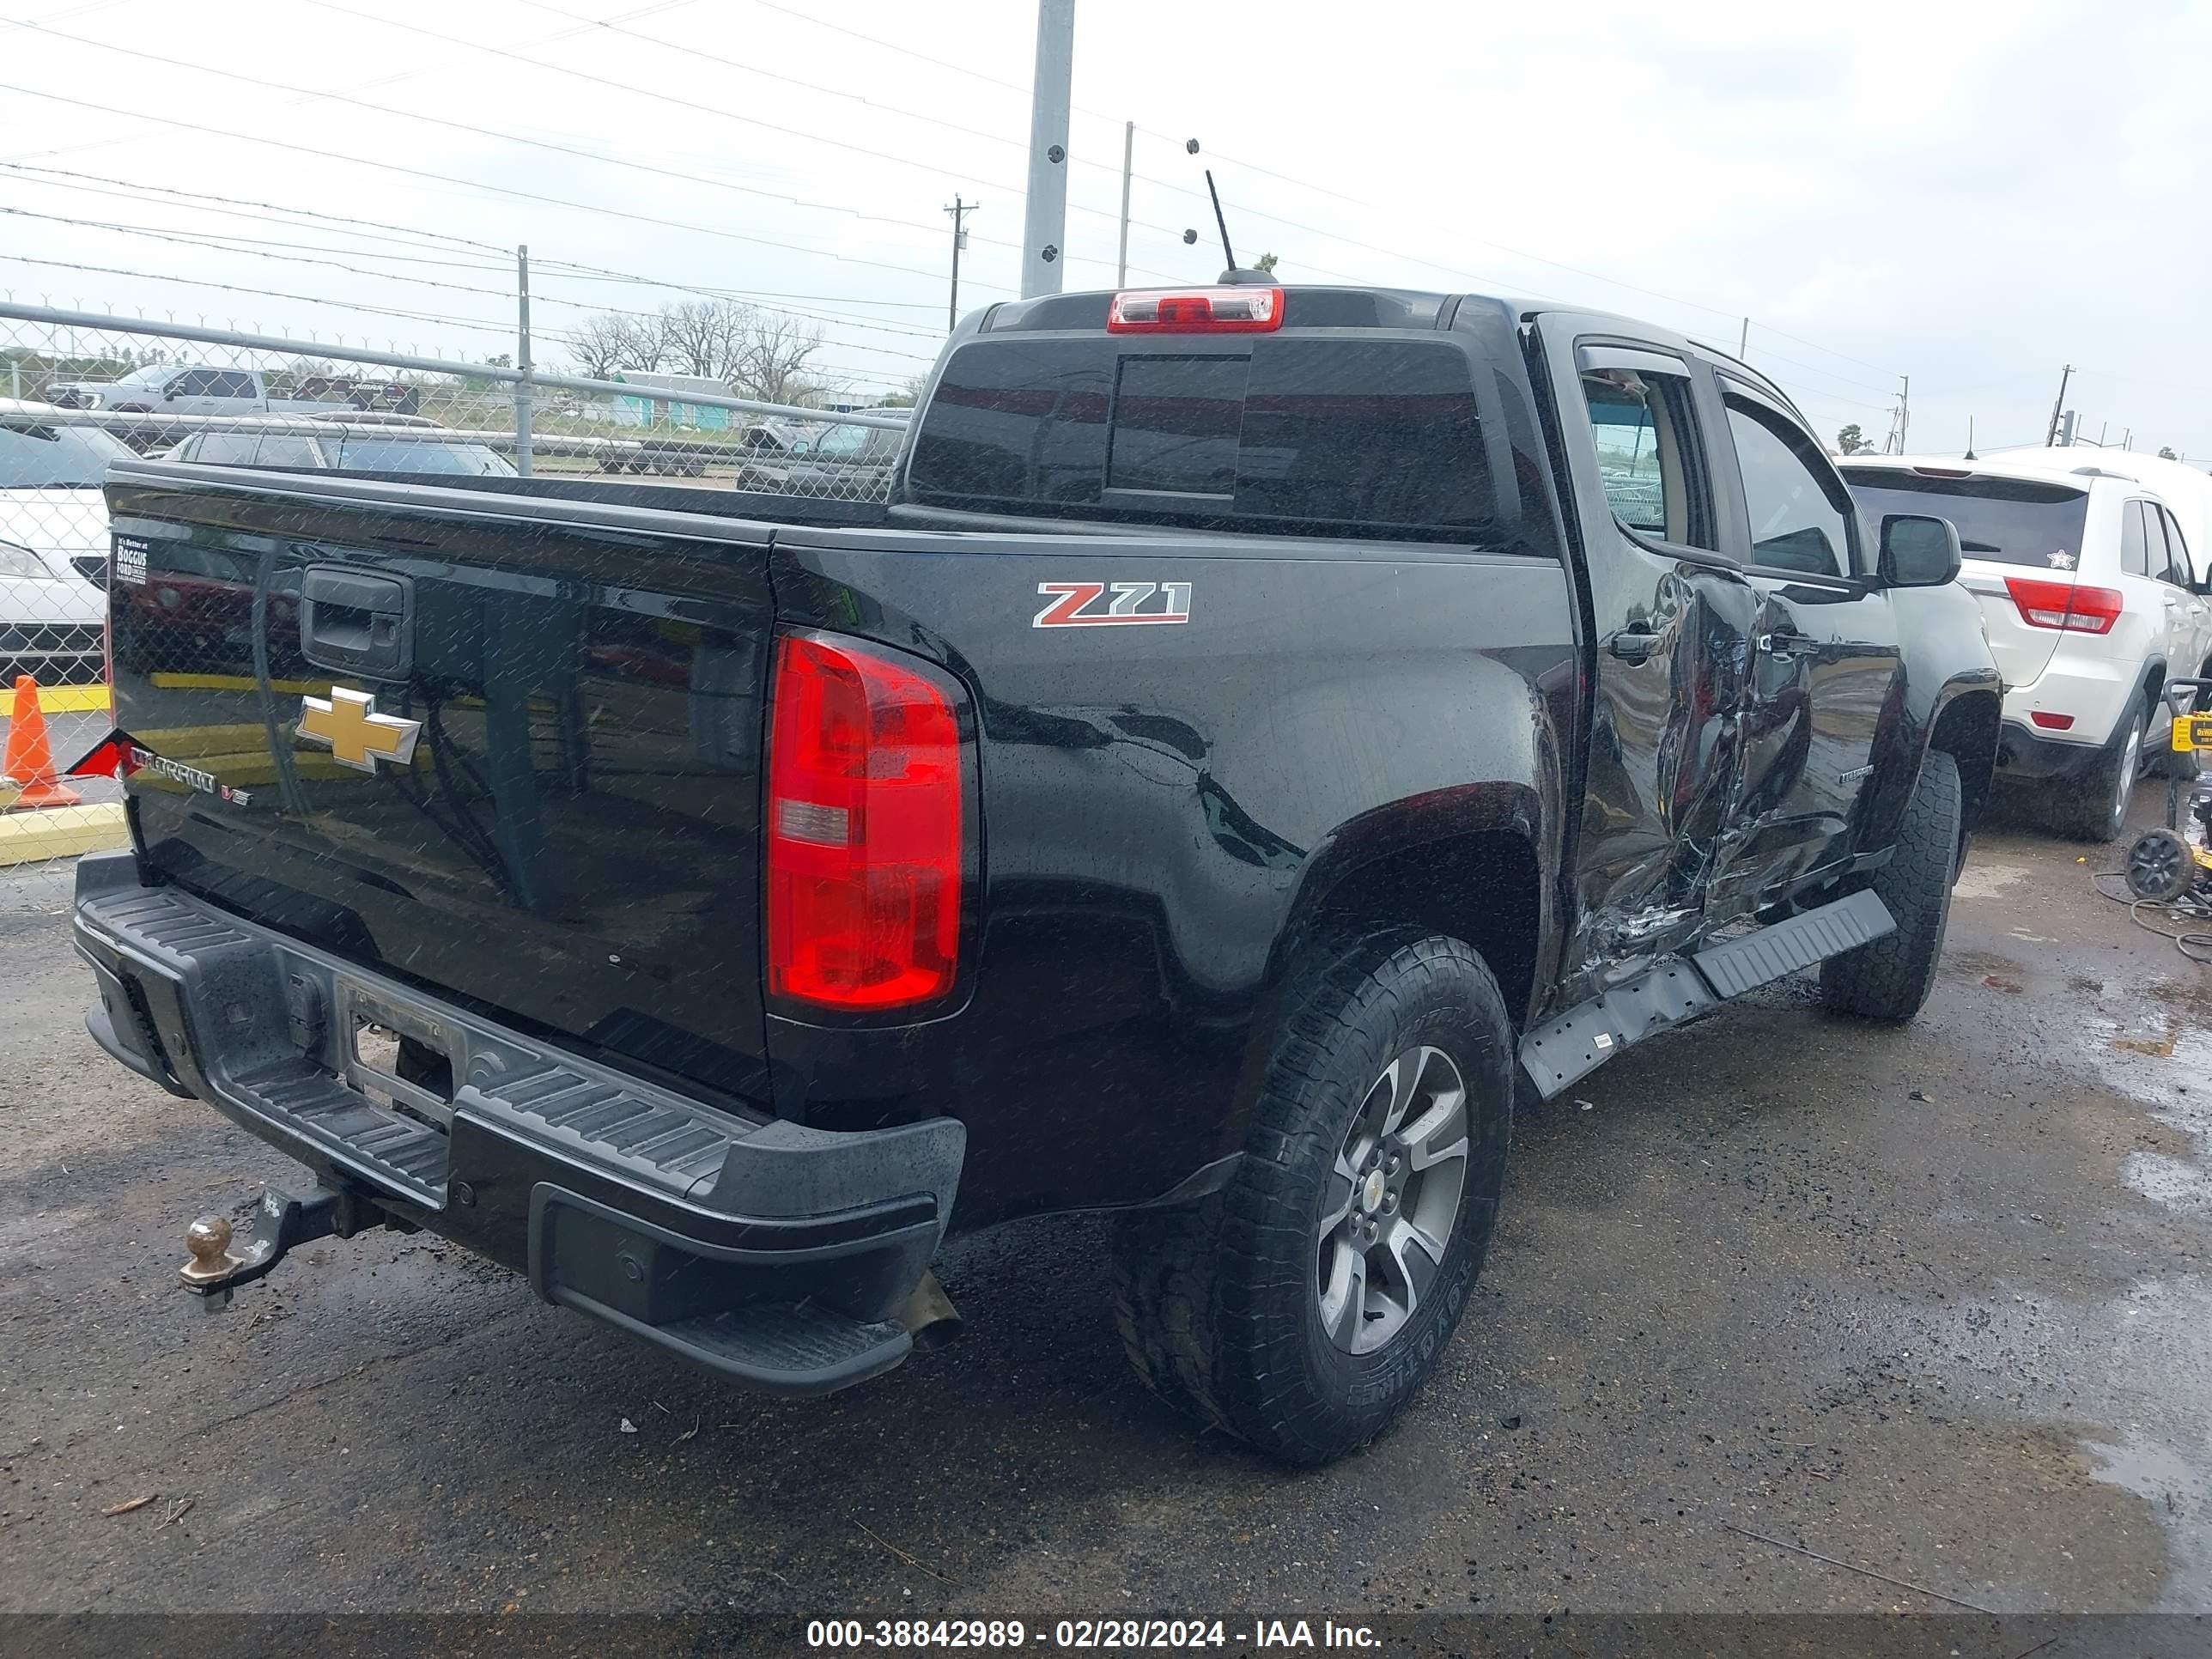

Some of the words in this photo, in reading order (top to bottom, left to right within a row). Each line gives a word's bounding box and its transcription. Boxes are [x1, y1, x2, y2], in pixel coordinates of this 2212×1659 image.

[126, 538, 142, 549] Better
[117, 544, 148, 567] BOGGUS
[117, 562, 132, 576] FORD
[1032, 582, 1193, 628] Z71
[221, 784, 254, 806] V6
